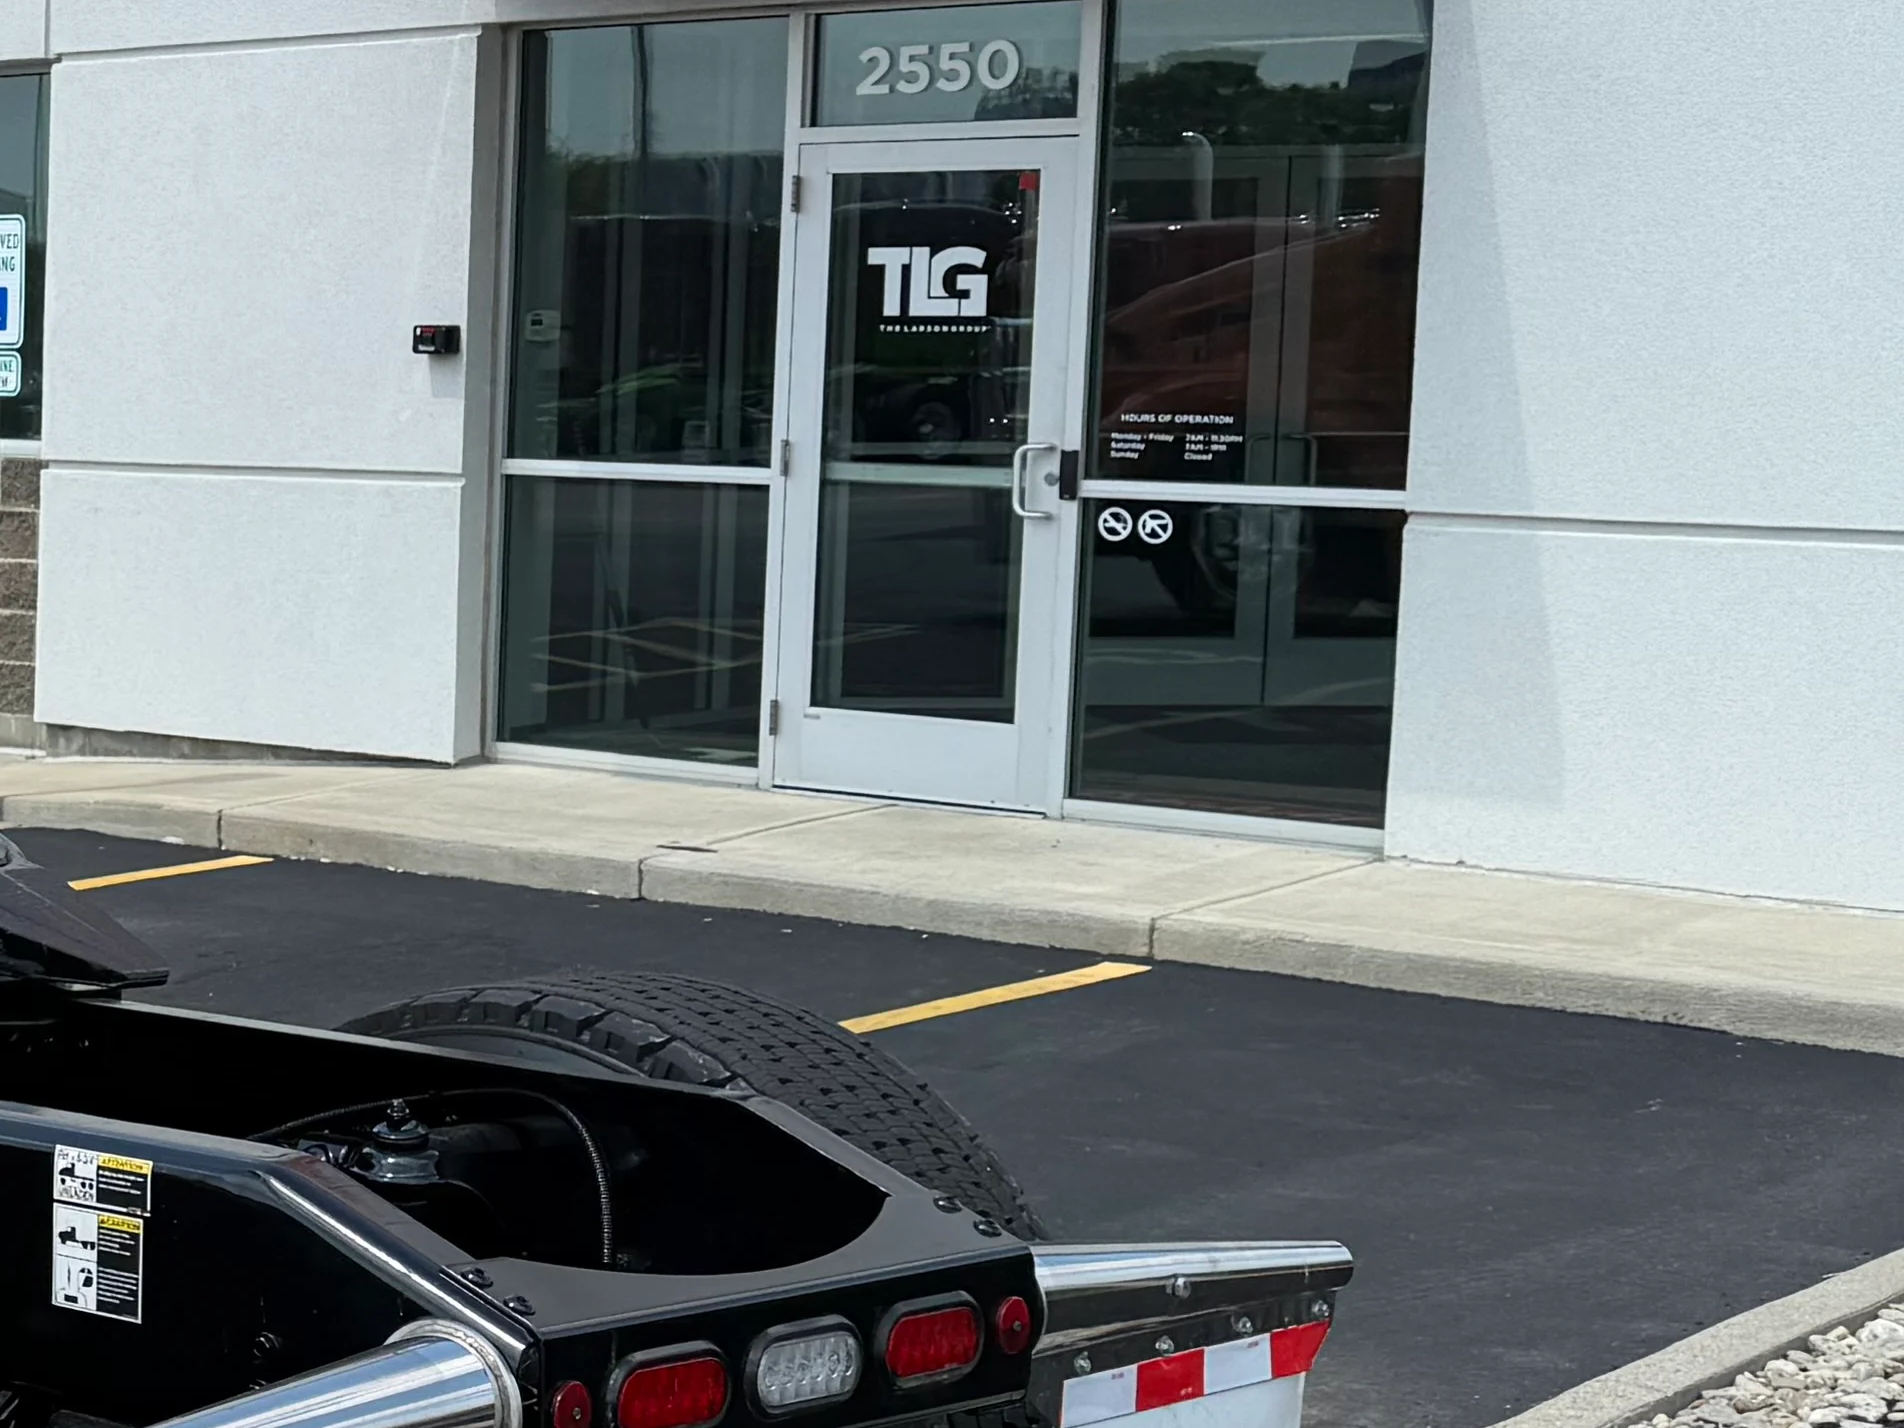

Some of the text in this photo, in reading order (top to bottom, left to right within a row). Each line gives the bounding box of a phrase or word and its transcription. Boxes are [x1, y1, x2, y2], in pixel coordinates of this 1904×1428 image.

[856, 39, 1020, 96] 2550
[867, 246, 988, 317] TLG
[1121, 414, 1234, 425] HOURS OF OPERATION
[1184, 452, 1213, 461] Closed
